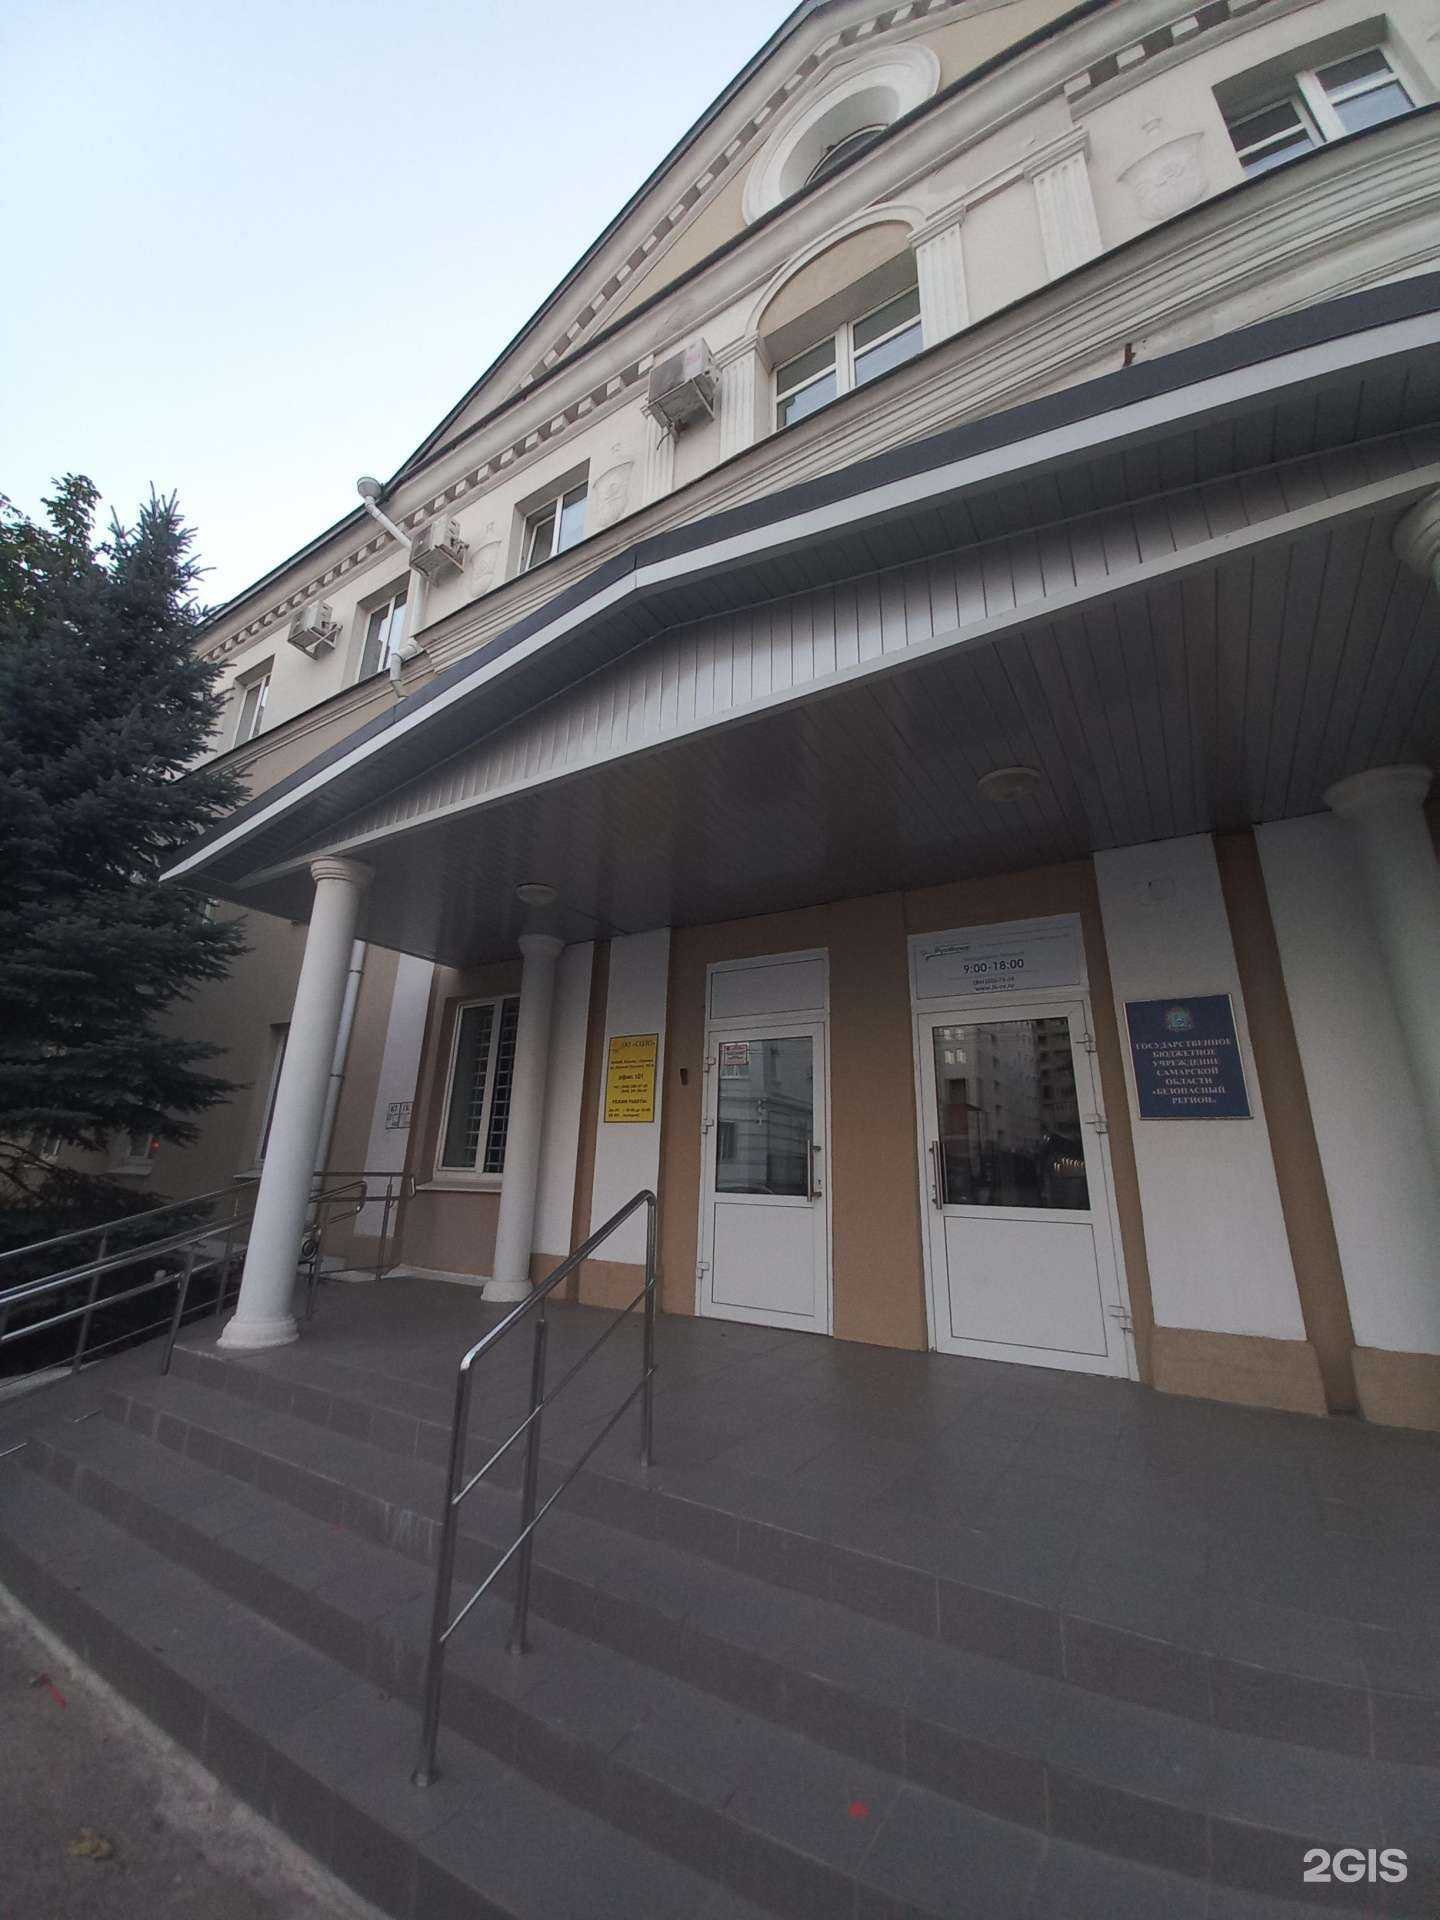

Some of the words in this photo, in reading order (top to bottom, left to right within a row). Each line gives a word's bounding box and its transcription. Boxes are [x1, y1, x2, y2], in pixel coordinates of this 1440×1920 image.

[963, 958, 1025, 974] 9:00-18:00
[1136, 1038, 1232, 1050] ГОСУДАРСТВЕННОЕ
[1152, 1048, 1216, 1058] БЮДЖЕТНОЕ
[1152, 1058, 1218, 1067] УЧРЕЖДЕНИЕ
[1156, 1066, 1219, 1076] САМАРСКОЙ
[1165, 1077, 1213, 1085] ОБЛАСТИ
